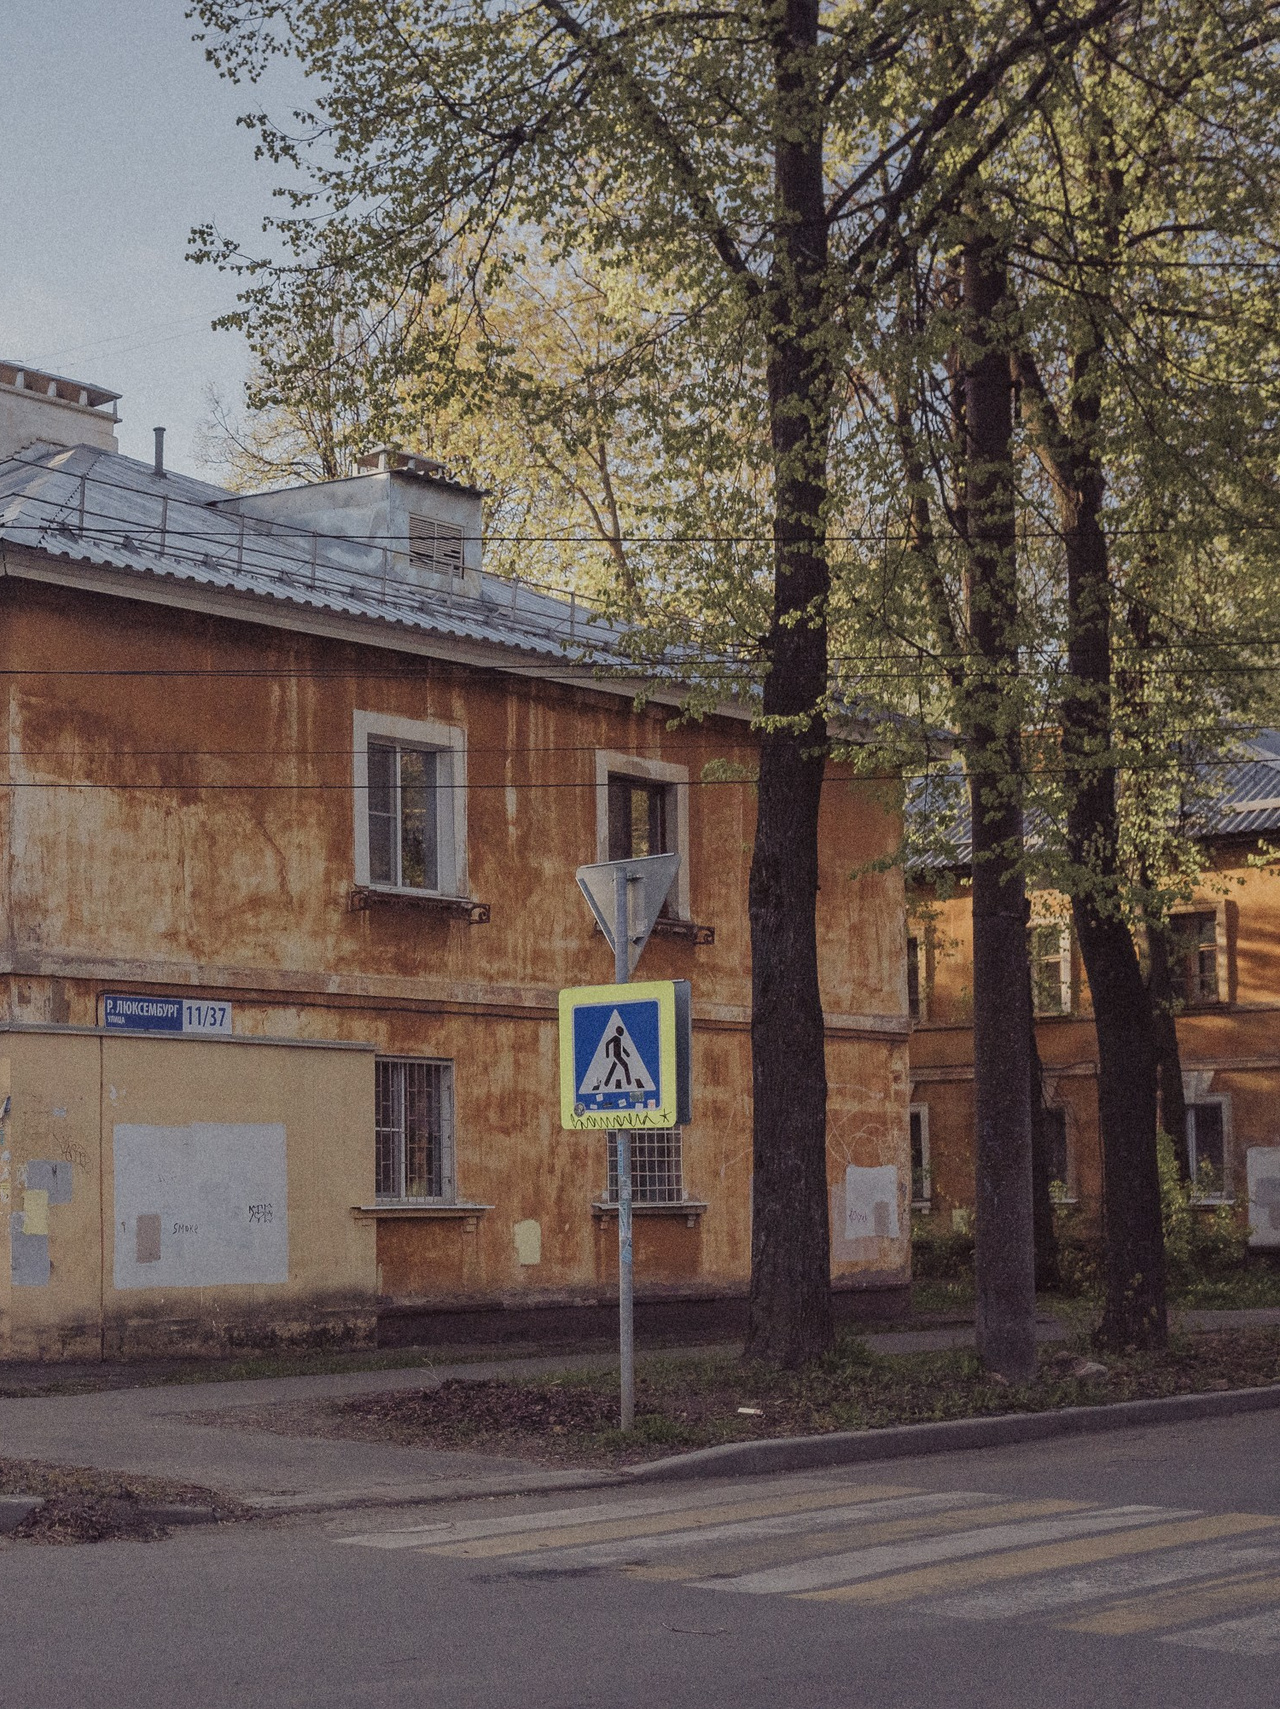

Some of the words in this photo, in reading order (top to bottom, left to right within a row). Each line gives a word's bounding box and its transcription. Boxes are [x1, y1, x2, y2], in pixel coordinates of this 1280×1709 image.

[107, 999, 115, 1014] Р.
[116, 1001, 180, 1018] ЛЮКСЕМБУРГ
[186, 1006, 226, 1027] 11/37
[107, 1016, 126, 1025] УЛИЦА
